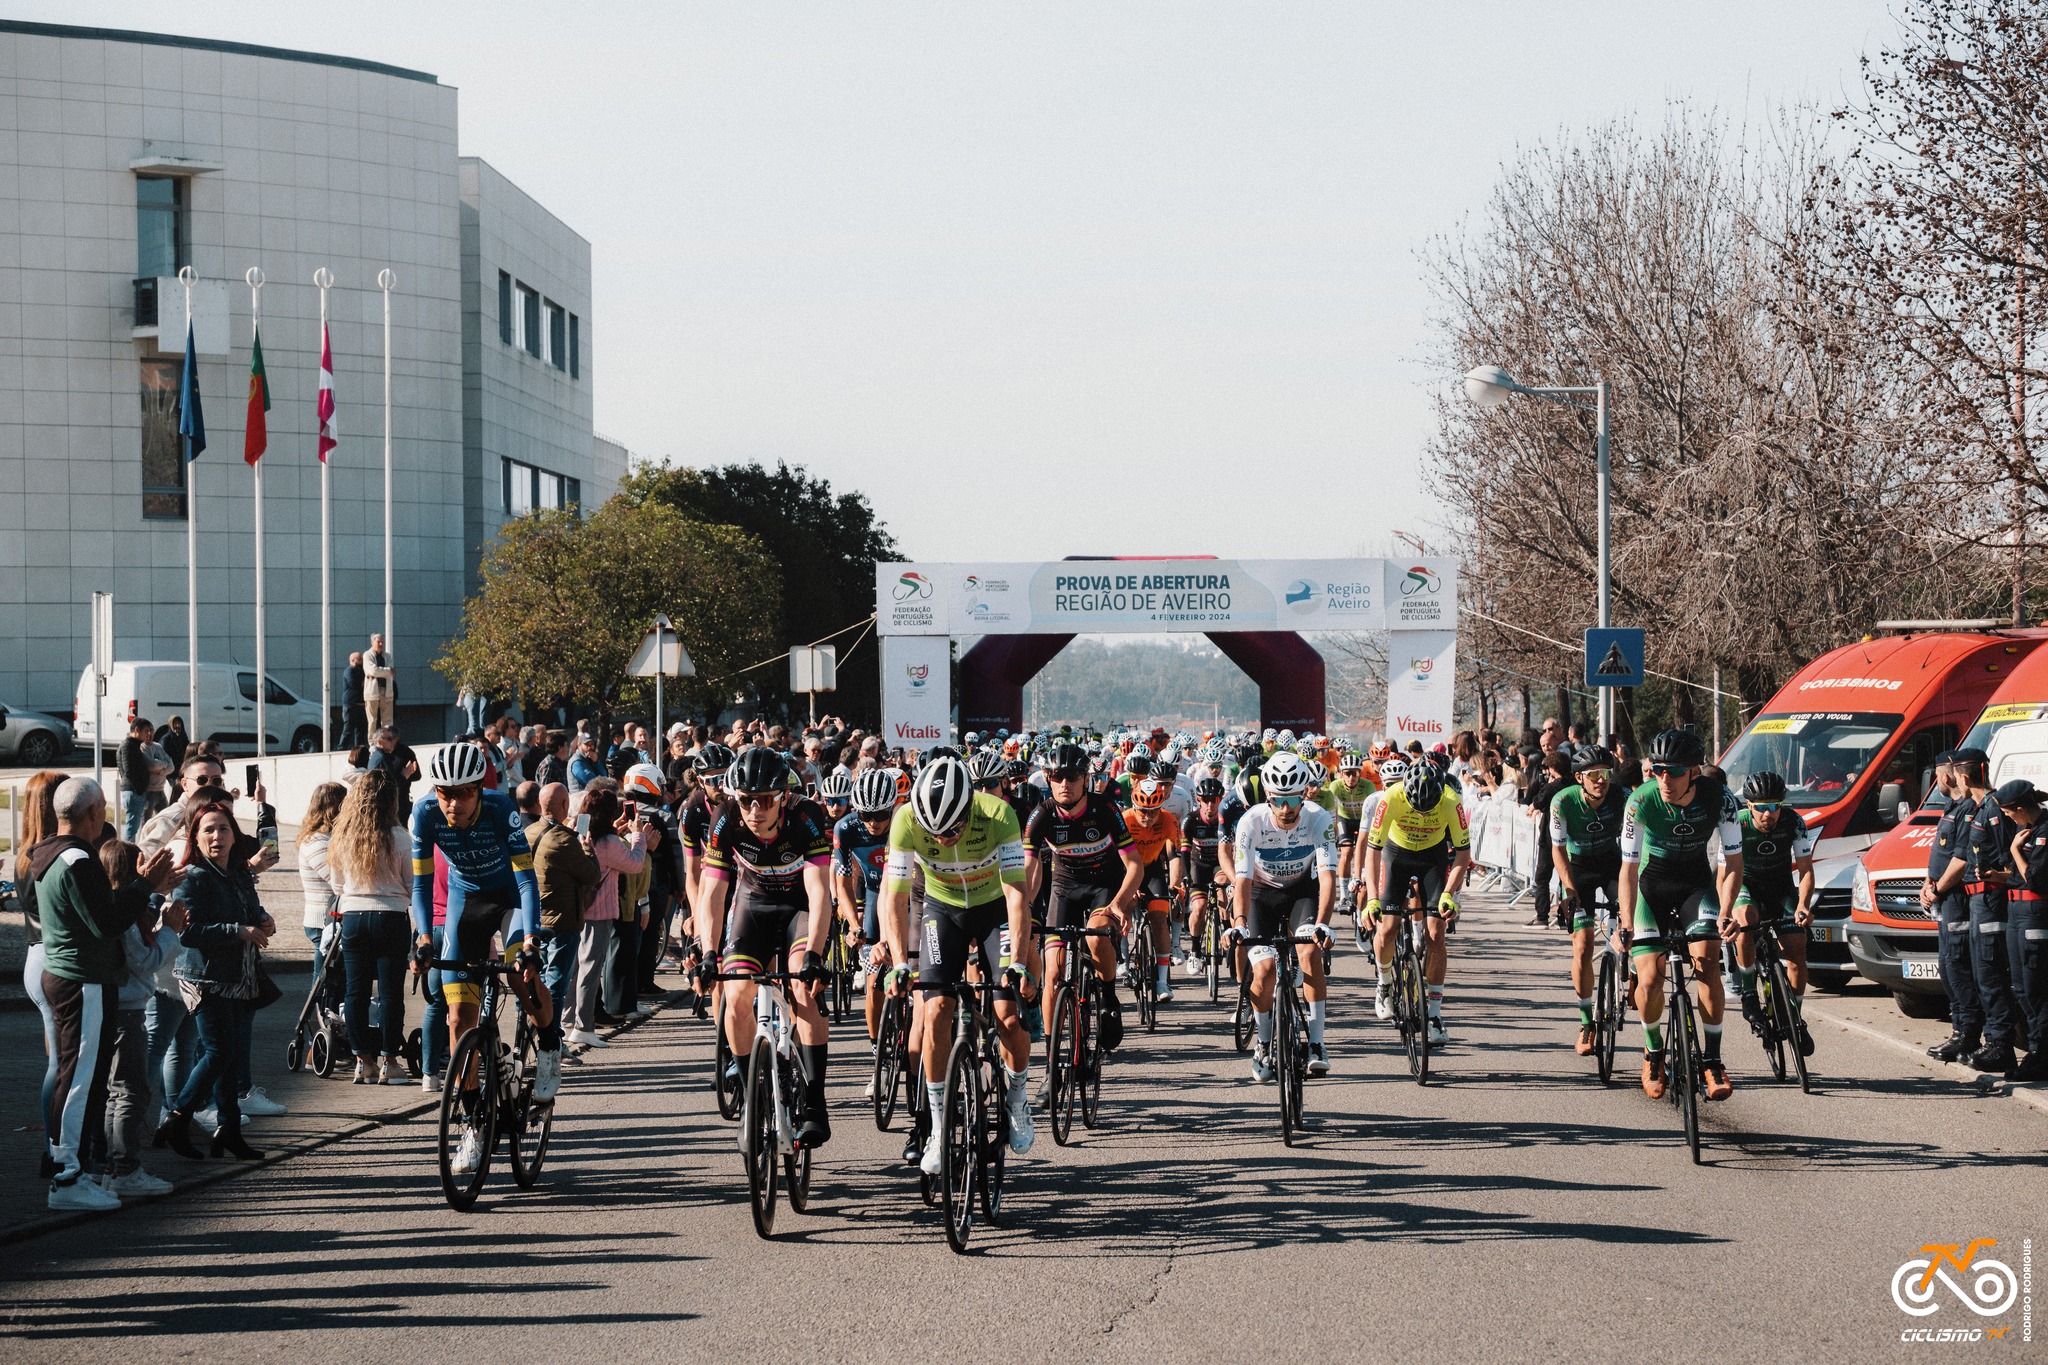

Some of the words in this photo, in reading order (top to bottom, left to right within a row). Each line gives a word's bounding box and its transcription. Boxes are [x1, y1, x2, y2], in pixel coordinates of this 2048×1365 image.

[1056, 576, 1112, 590] PROVA
[1116, 576, 1138, 590] DE
[1141, 575, 1230, 590] ABERTURA
[1327, 583, 1370, 597] Região
[1056, 591, 1126, 611] REGIÃO
[1132, 594, 1156, 610] DE
[1162, 593, 1231, 610] AVEIRO
[1328, 598, 1370, 609] Aveiro
[895, 721, 941, 739] Vitalis
[1397, 714, 1442, 733] Vitalis
